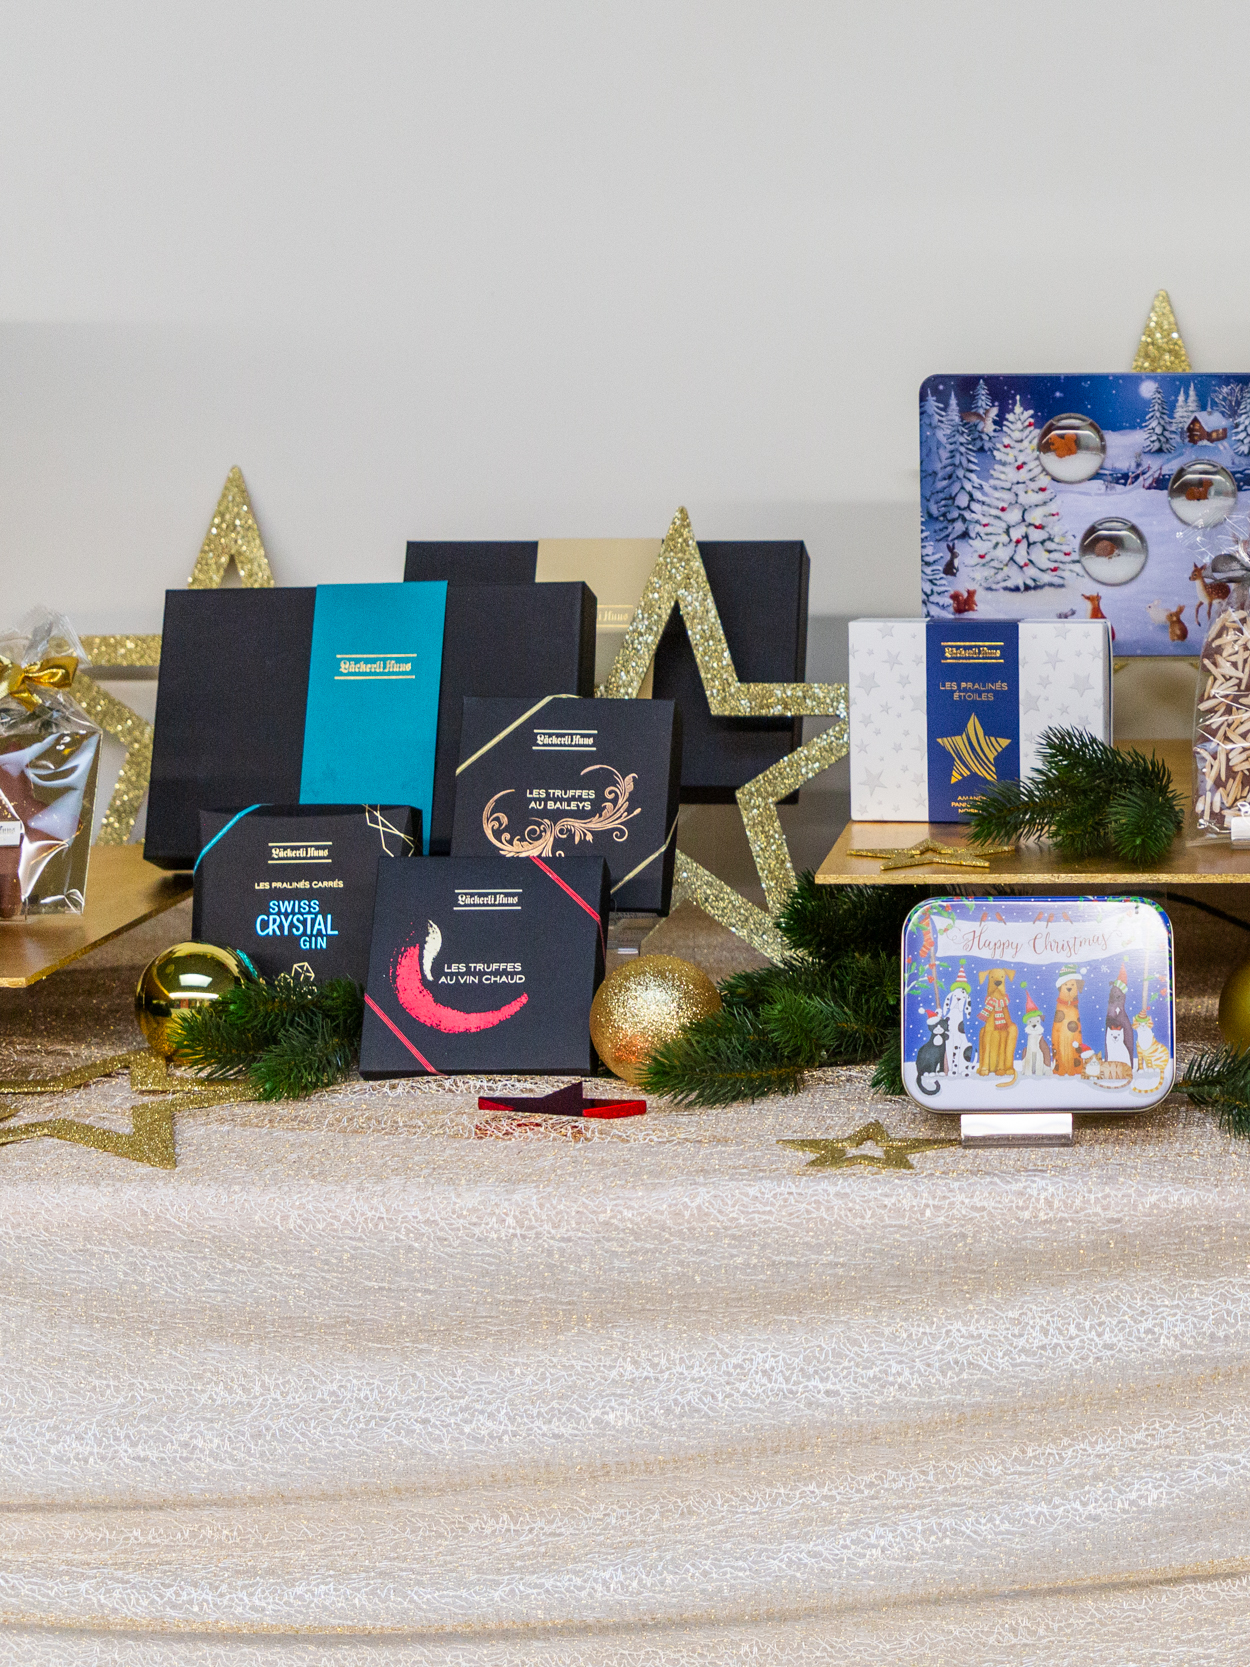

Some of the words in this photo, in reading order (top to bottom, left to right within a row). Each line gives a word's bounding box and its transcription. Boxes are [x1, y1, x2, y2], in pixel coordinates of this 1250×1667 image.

[339, 660, 383, 673] Läckerli
[384, 660, 411, 672] Huus
[940, 682, 957, 690] LES
[961, 680, 1008, 690] PRALINÉS
[953, 690, 994, 701] ÉTOILES
[536, 734, 571, 745] Läckerli
[572, 734, 594, 745] Huus
[526, 789, 546, 798] LES
[548, 789, 596, 799] TRUFFES
[529, 801, 545, 810] AU
[547, 801, 591, 810] BAILEYS
[271, 847, 306, 858] Läckerli
[307, 847, 329, 857] Huus
[255, 882, 270, 890] LES
[272, 879, 310, 889] PRALINÉS
[312, 879, 344, 889] CARRÉS
[457, 894, 494, 905] Läckerli
[495, 894, 518, 904] Huus
[269, 899, 319, 913] SWISS
[255, 913, 339, 936] CRYSTAL
[300, 936, 328, 950] GIN
[960, 925, 1023, 959] Happy
[1028, 929, 1120, 959] Christmas
[444, 963, 466, 972] LES
[469, 963, 522, 972] TRUFFES
[438, 975, 456, 984] AU
[458, 975, 479, 984] VIN
[482, 974, 526, 984] CHAUD
